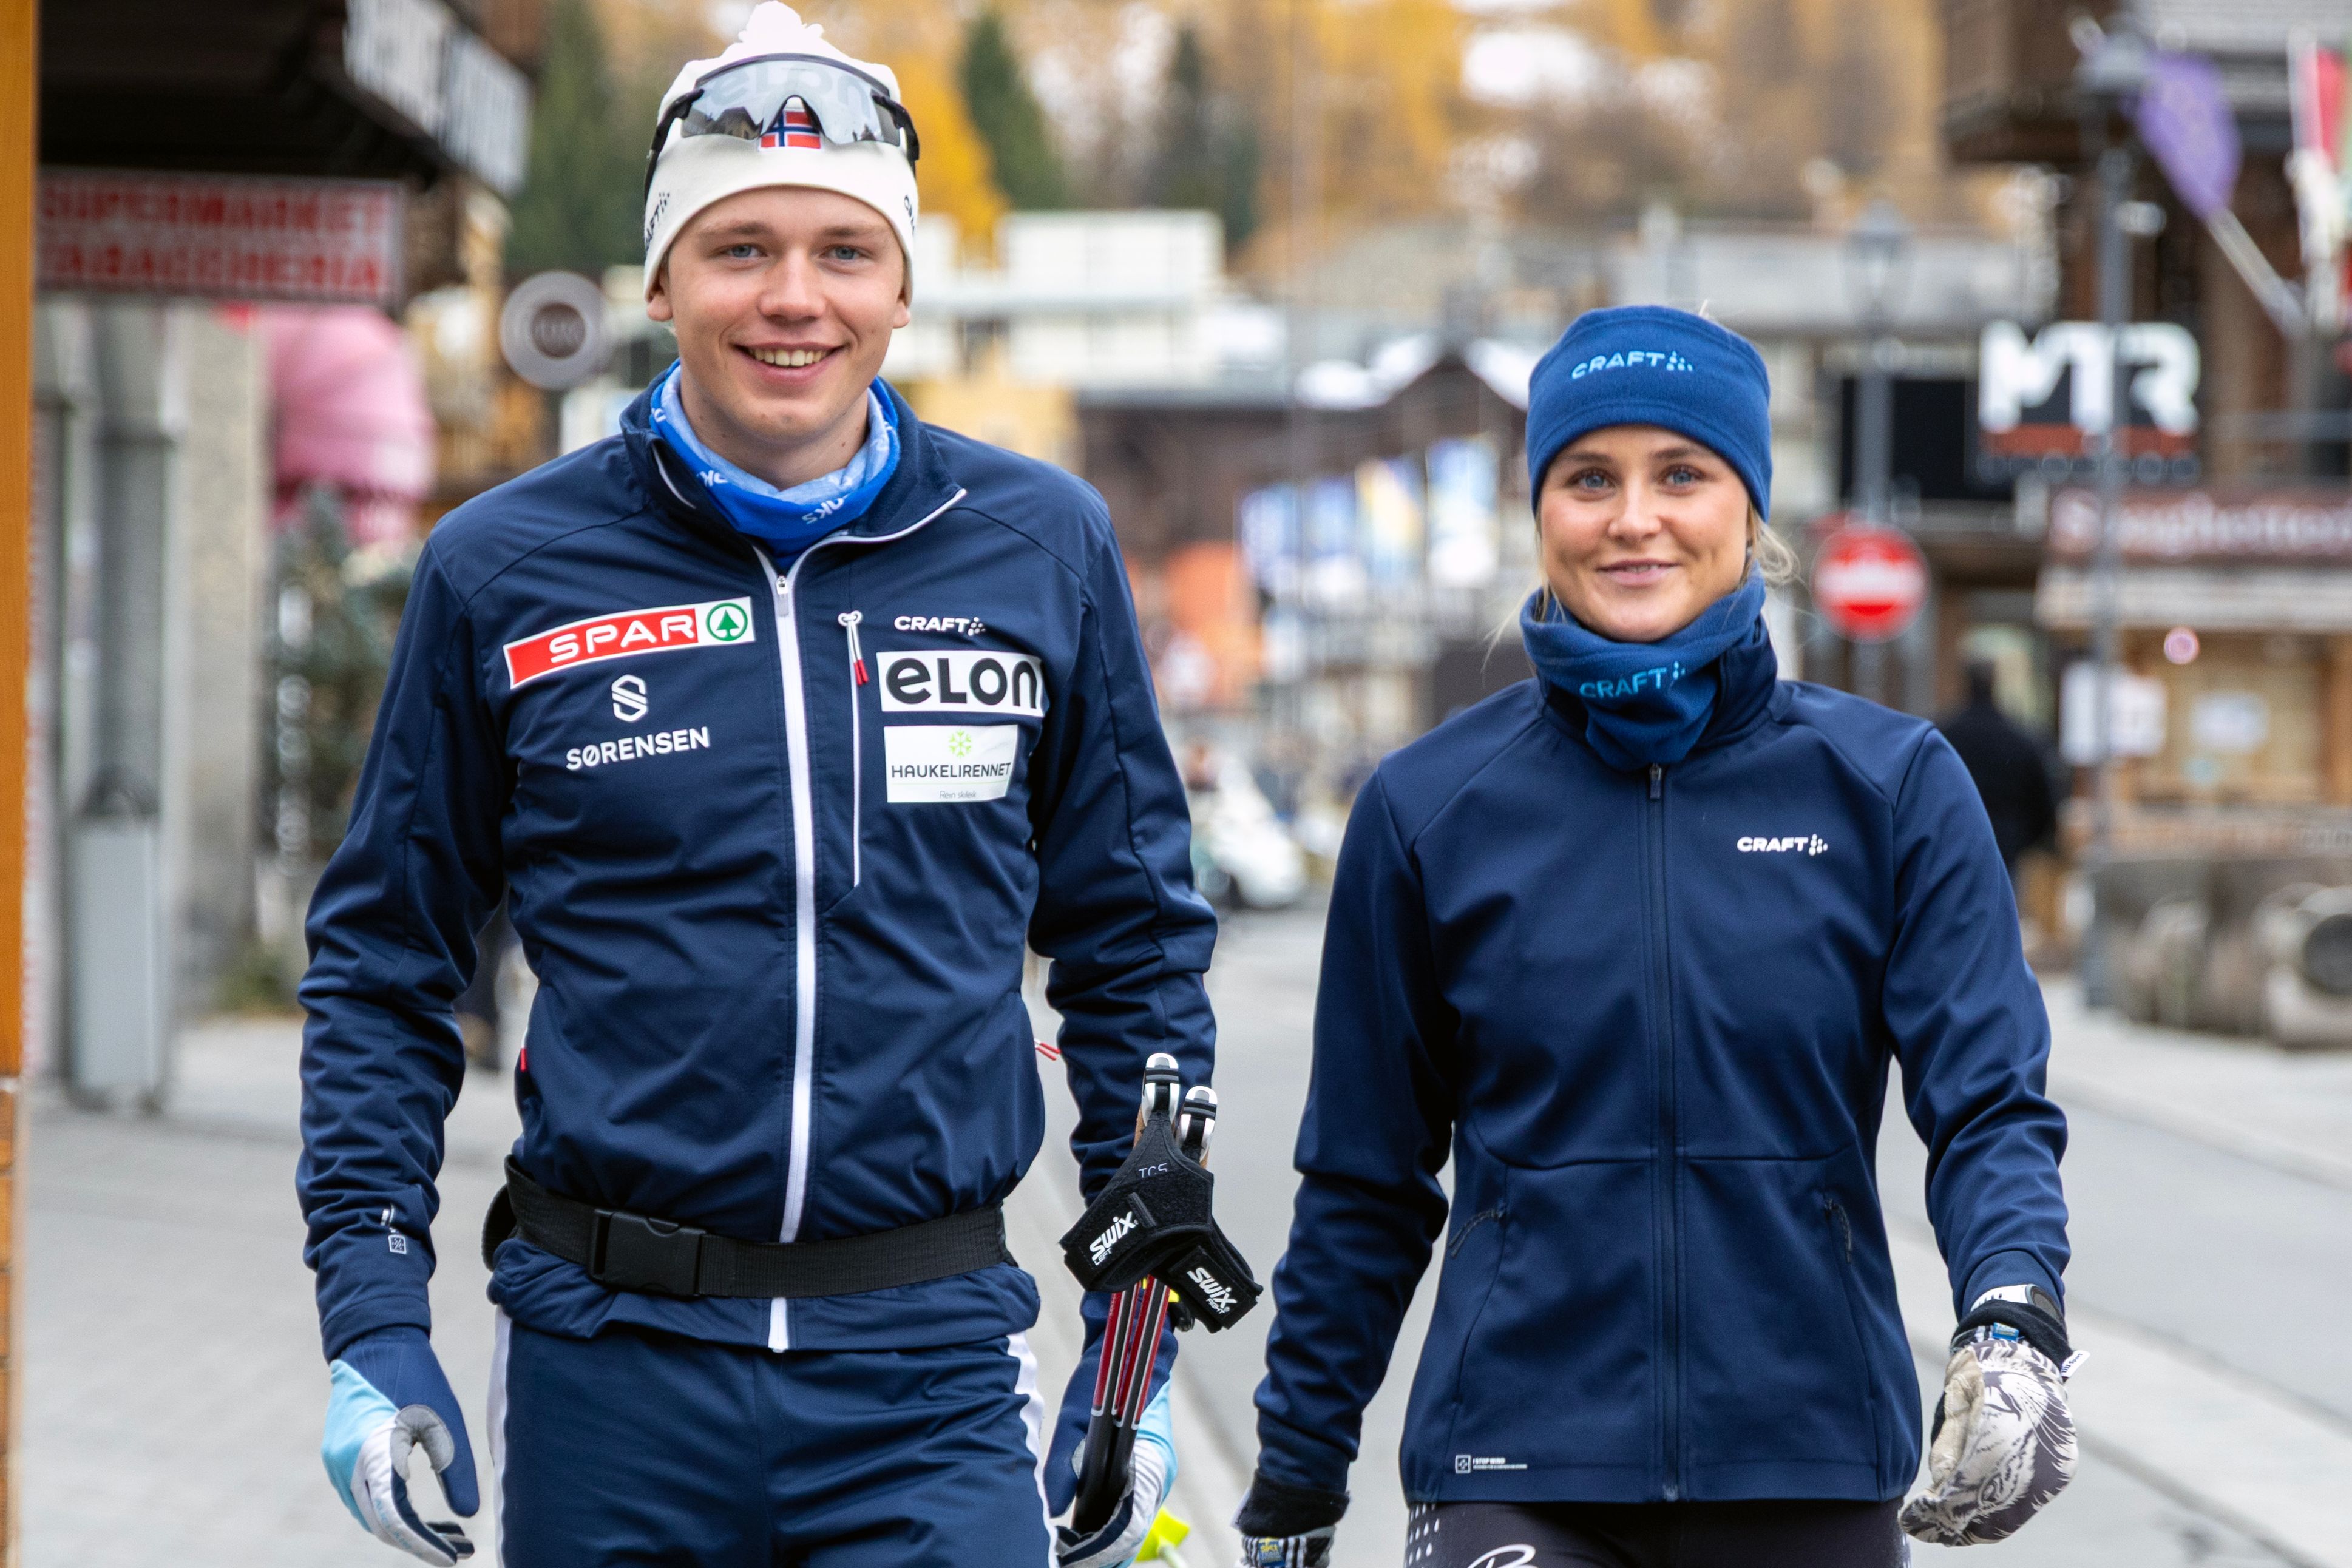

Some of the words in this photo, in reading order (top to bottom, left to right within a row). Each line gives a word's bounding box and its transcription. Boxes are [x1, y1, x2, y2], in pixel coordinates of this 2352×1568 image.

[1571, 350, 1666, 380] CRAFT
[894, 615, 970, 632] CRAFT
[549, 614, 695, 664] SPAR
[1579, 667, 1667, 698] CRAFT
[566, 726, 711, 771] SØRENSEN
[891, 762, 1011, 778] HAUKELIRENNET
[1737, 836, 1809, 852] CRAFT
